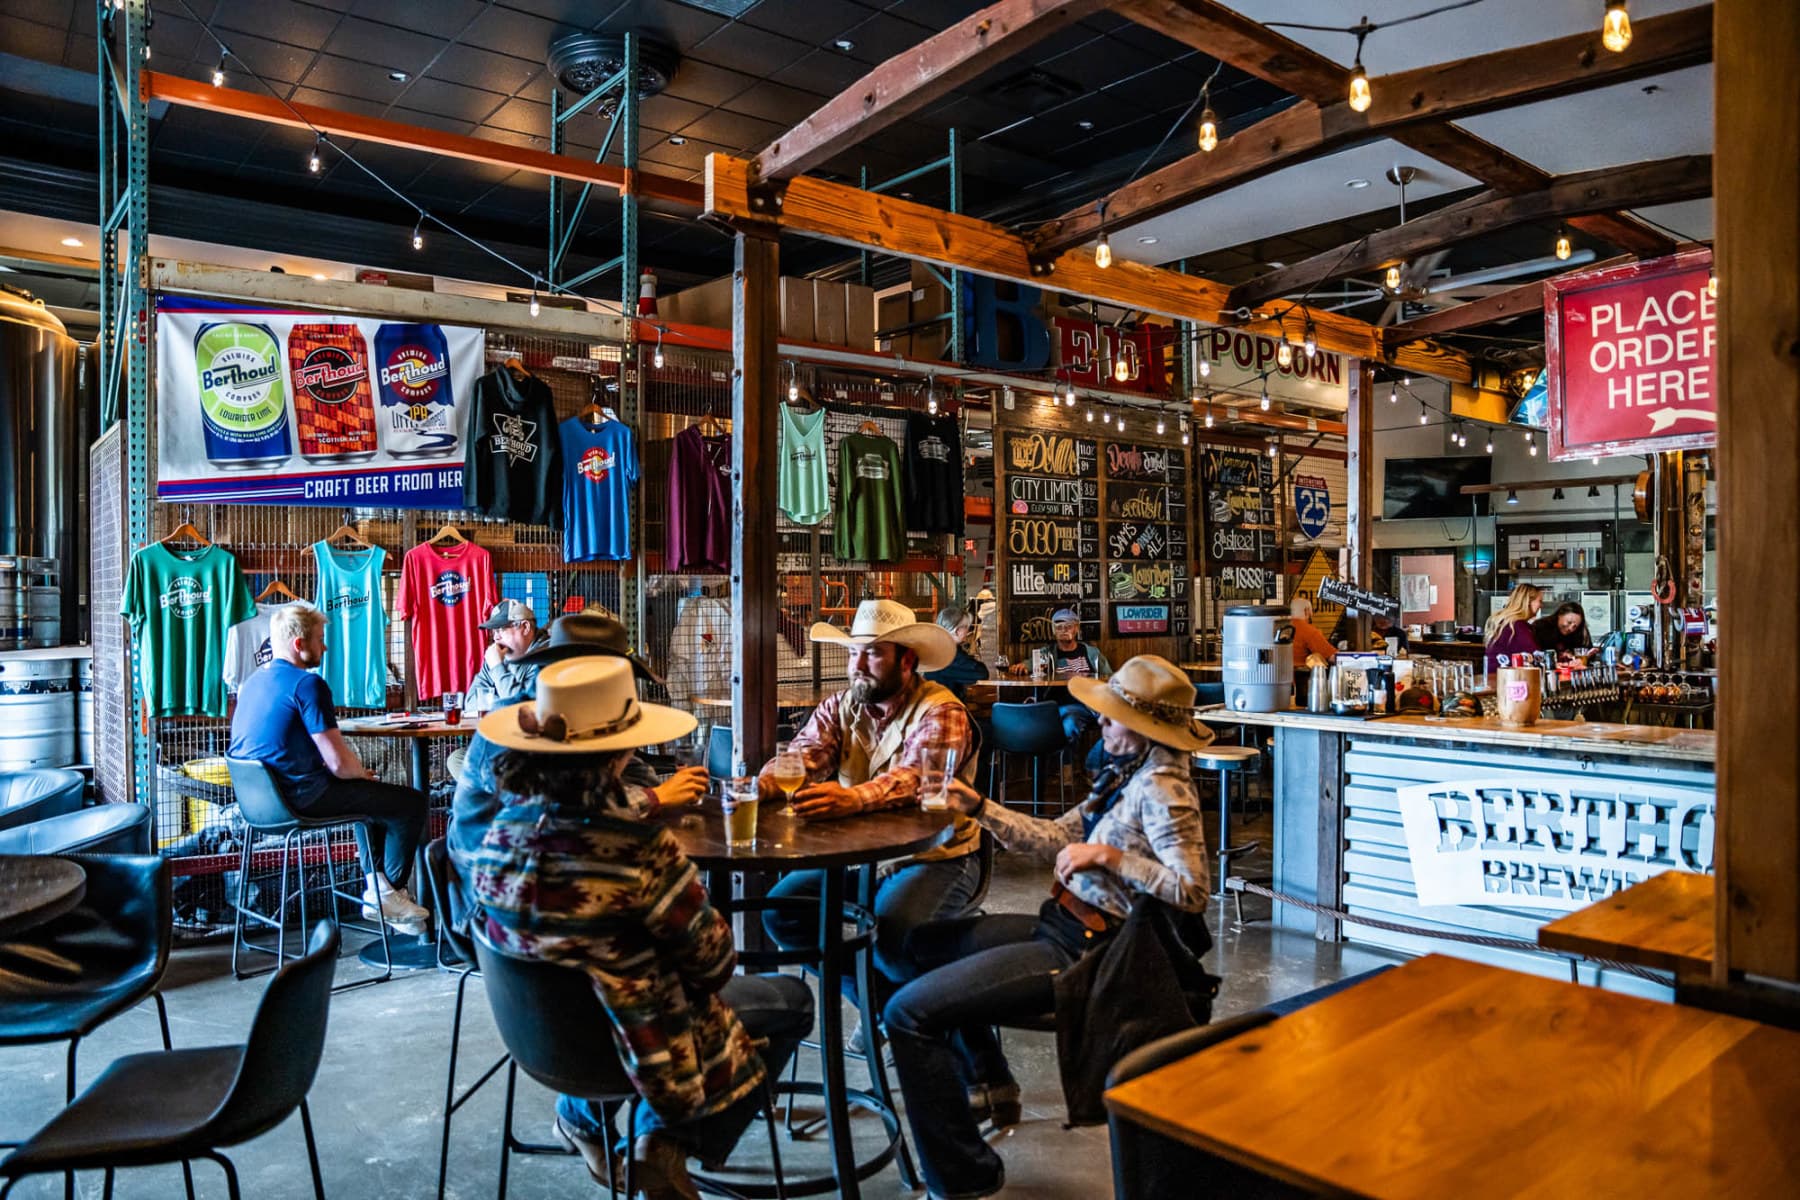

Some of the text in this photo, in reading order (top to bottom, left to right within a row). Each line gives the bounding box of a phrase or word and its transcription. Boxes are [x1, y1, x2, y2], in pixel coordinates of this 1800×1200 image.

[1591, 288, 1716, 338] PLACE
[380, 353, 446, 386] Berthoud
[1211, 328, 1340, 385] POPCORN
[202, 355, 276, 391] Berthoud
[295, 352, 364, 390] Berthoud
[1608, 366, 1710, 409] HERE
[219, 407, 256, 423] LOWRIDER
[410, 406, 428, 420] IPA
[494, 436, 532, 453] BERHOUD
[305, 478, 350, 498] CRAFT
[355, 475, 389, 495] BEER
[394, 472, 433, 492] FROM
[1012, 479, 1079, 502] CITY LIMITS
[1300, 489, 1328, 526] 25
[1010, 519, 1058, 556] 5030
[1054, 563, 1071, 582] IPA
[160, 585, 212, 609] Berthoud
[327, 590, 370, 612] Berthoud
[430, 577, 471, 599] Berthoud
[1122, 607, 1163, 619] LOWRIDER
[1429, 788, 1715, 875] BERTHO
